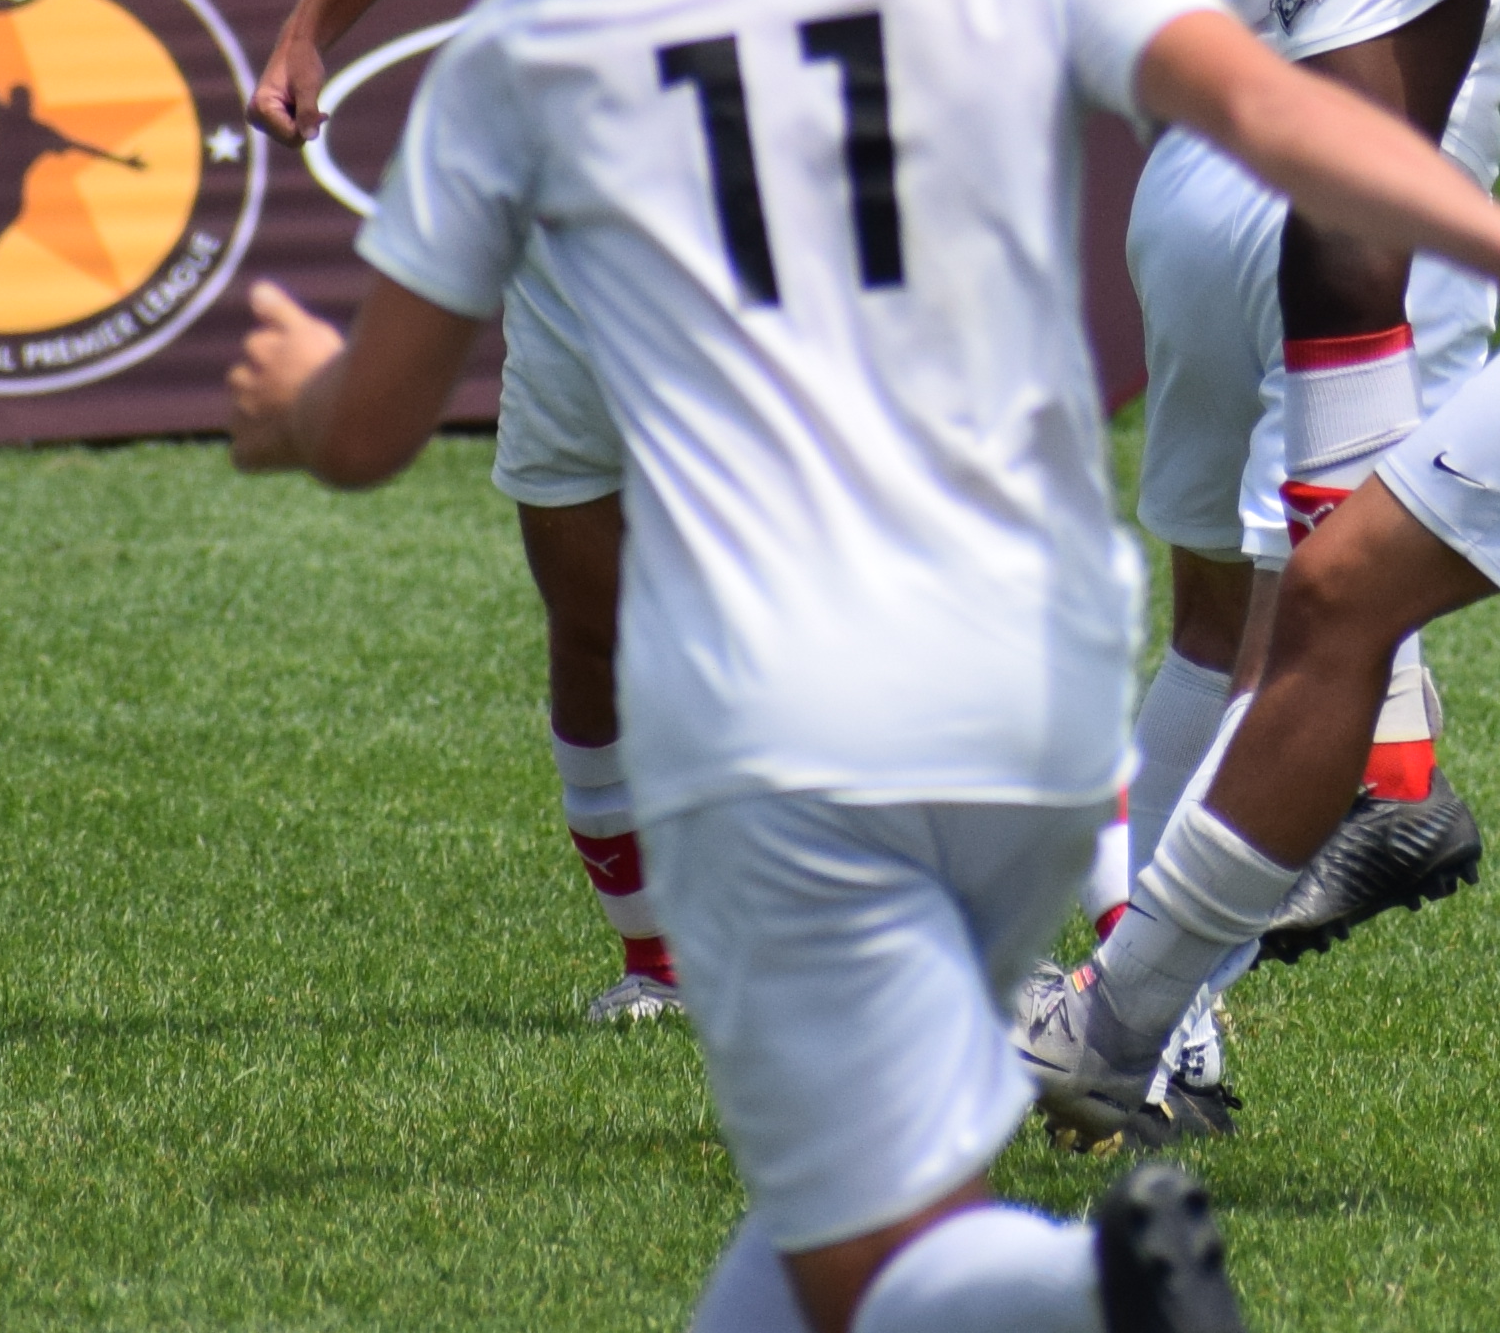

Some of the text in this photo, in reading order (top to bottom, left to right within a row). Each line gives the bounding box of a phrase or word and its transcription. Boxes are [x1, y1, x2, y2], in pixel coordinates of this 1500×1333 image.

[656, 12, 906, 309] 11
[22, 311, 139, 367] PREMIER
[135, 232, 220, 324] LEAGUE
